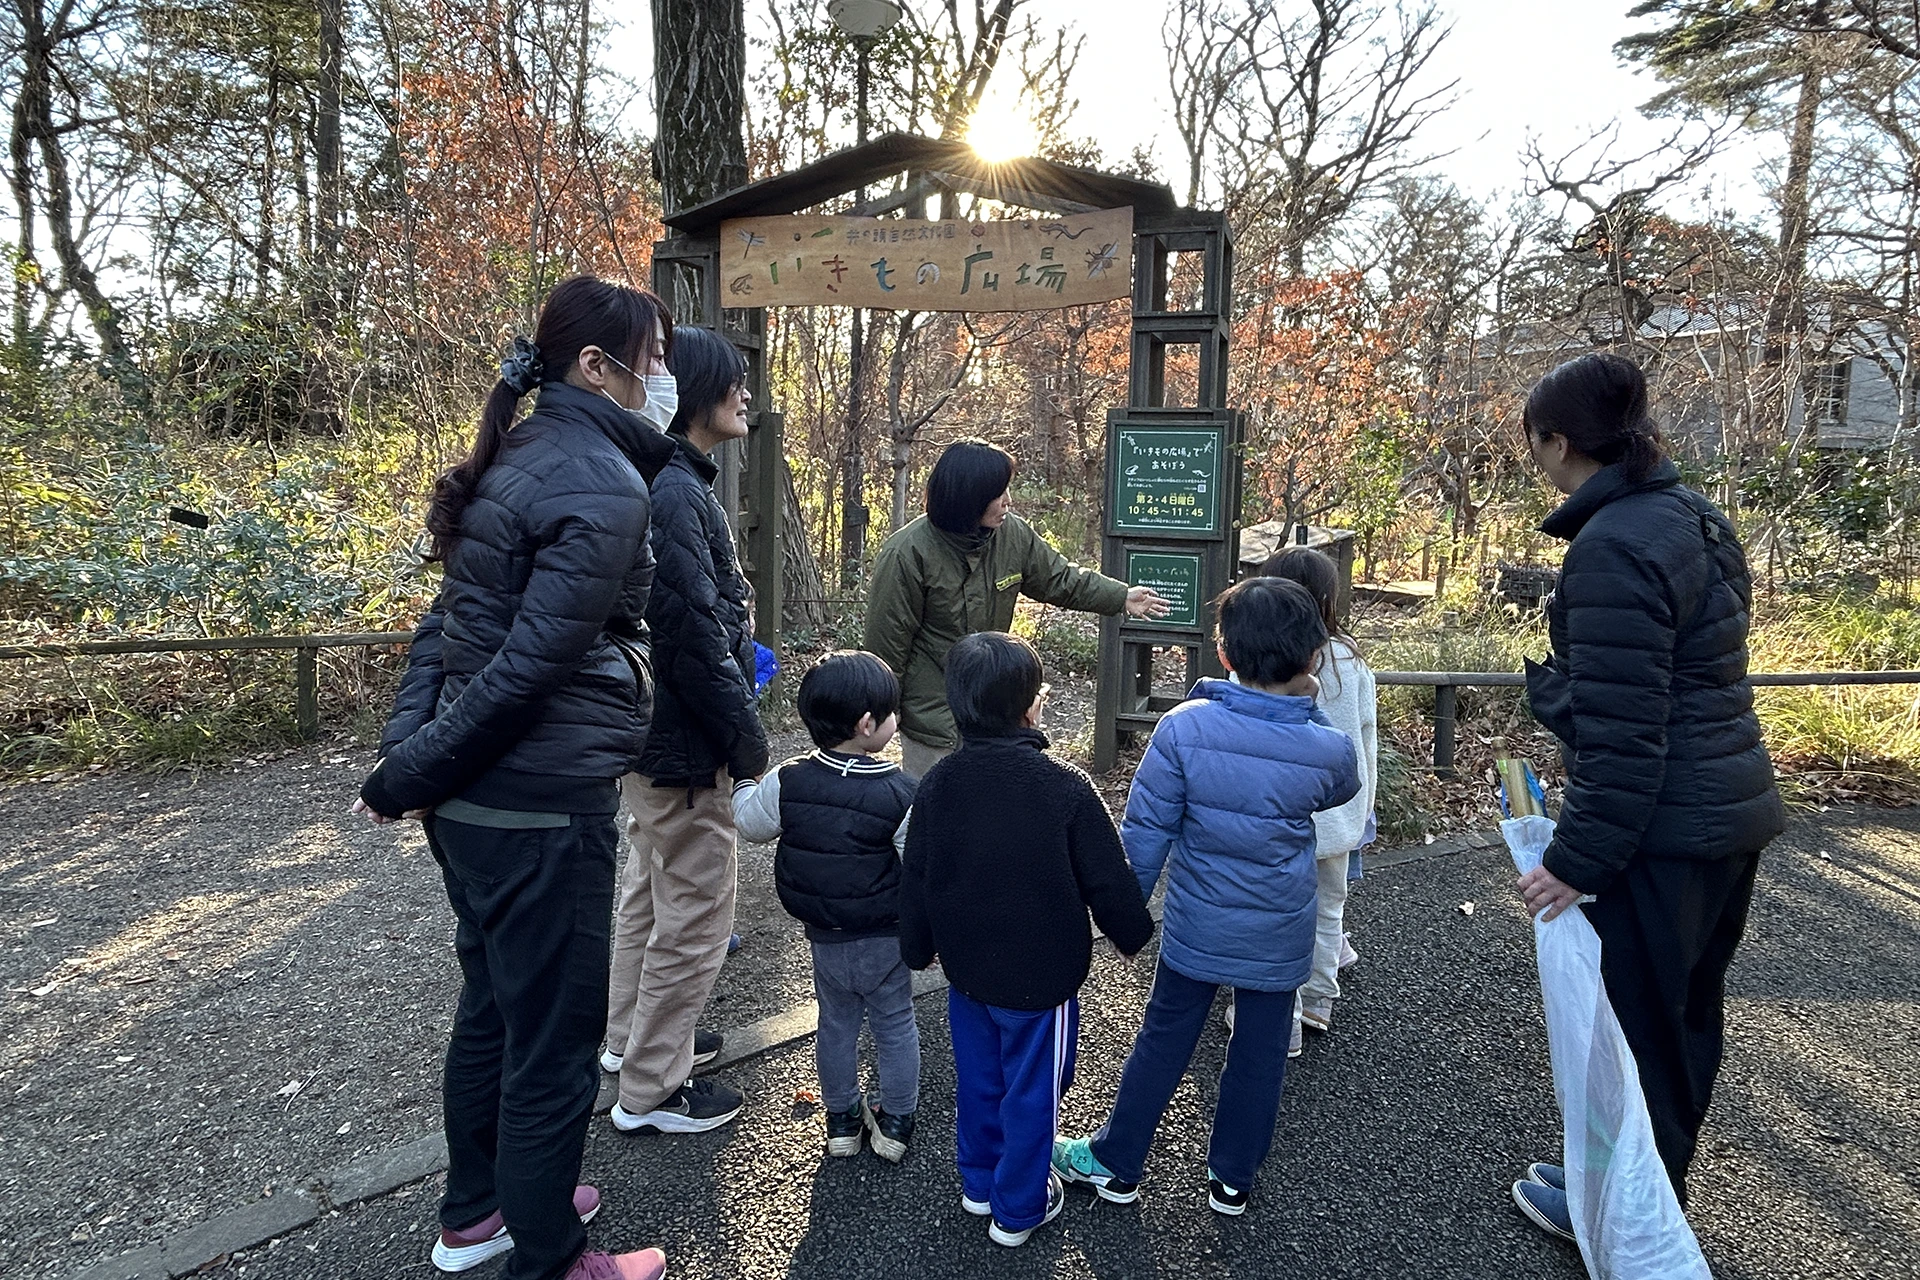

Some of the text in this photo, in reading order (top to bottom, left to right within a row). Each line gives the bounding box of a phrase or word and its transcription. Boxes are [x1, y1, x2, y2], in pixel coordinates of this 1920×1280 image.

[846, 223, 956, 245] 井の頭自然文化園
[769, 244, 1068, 295] いきもの広場
[1151, 460, 1186, 470] あそぼう
